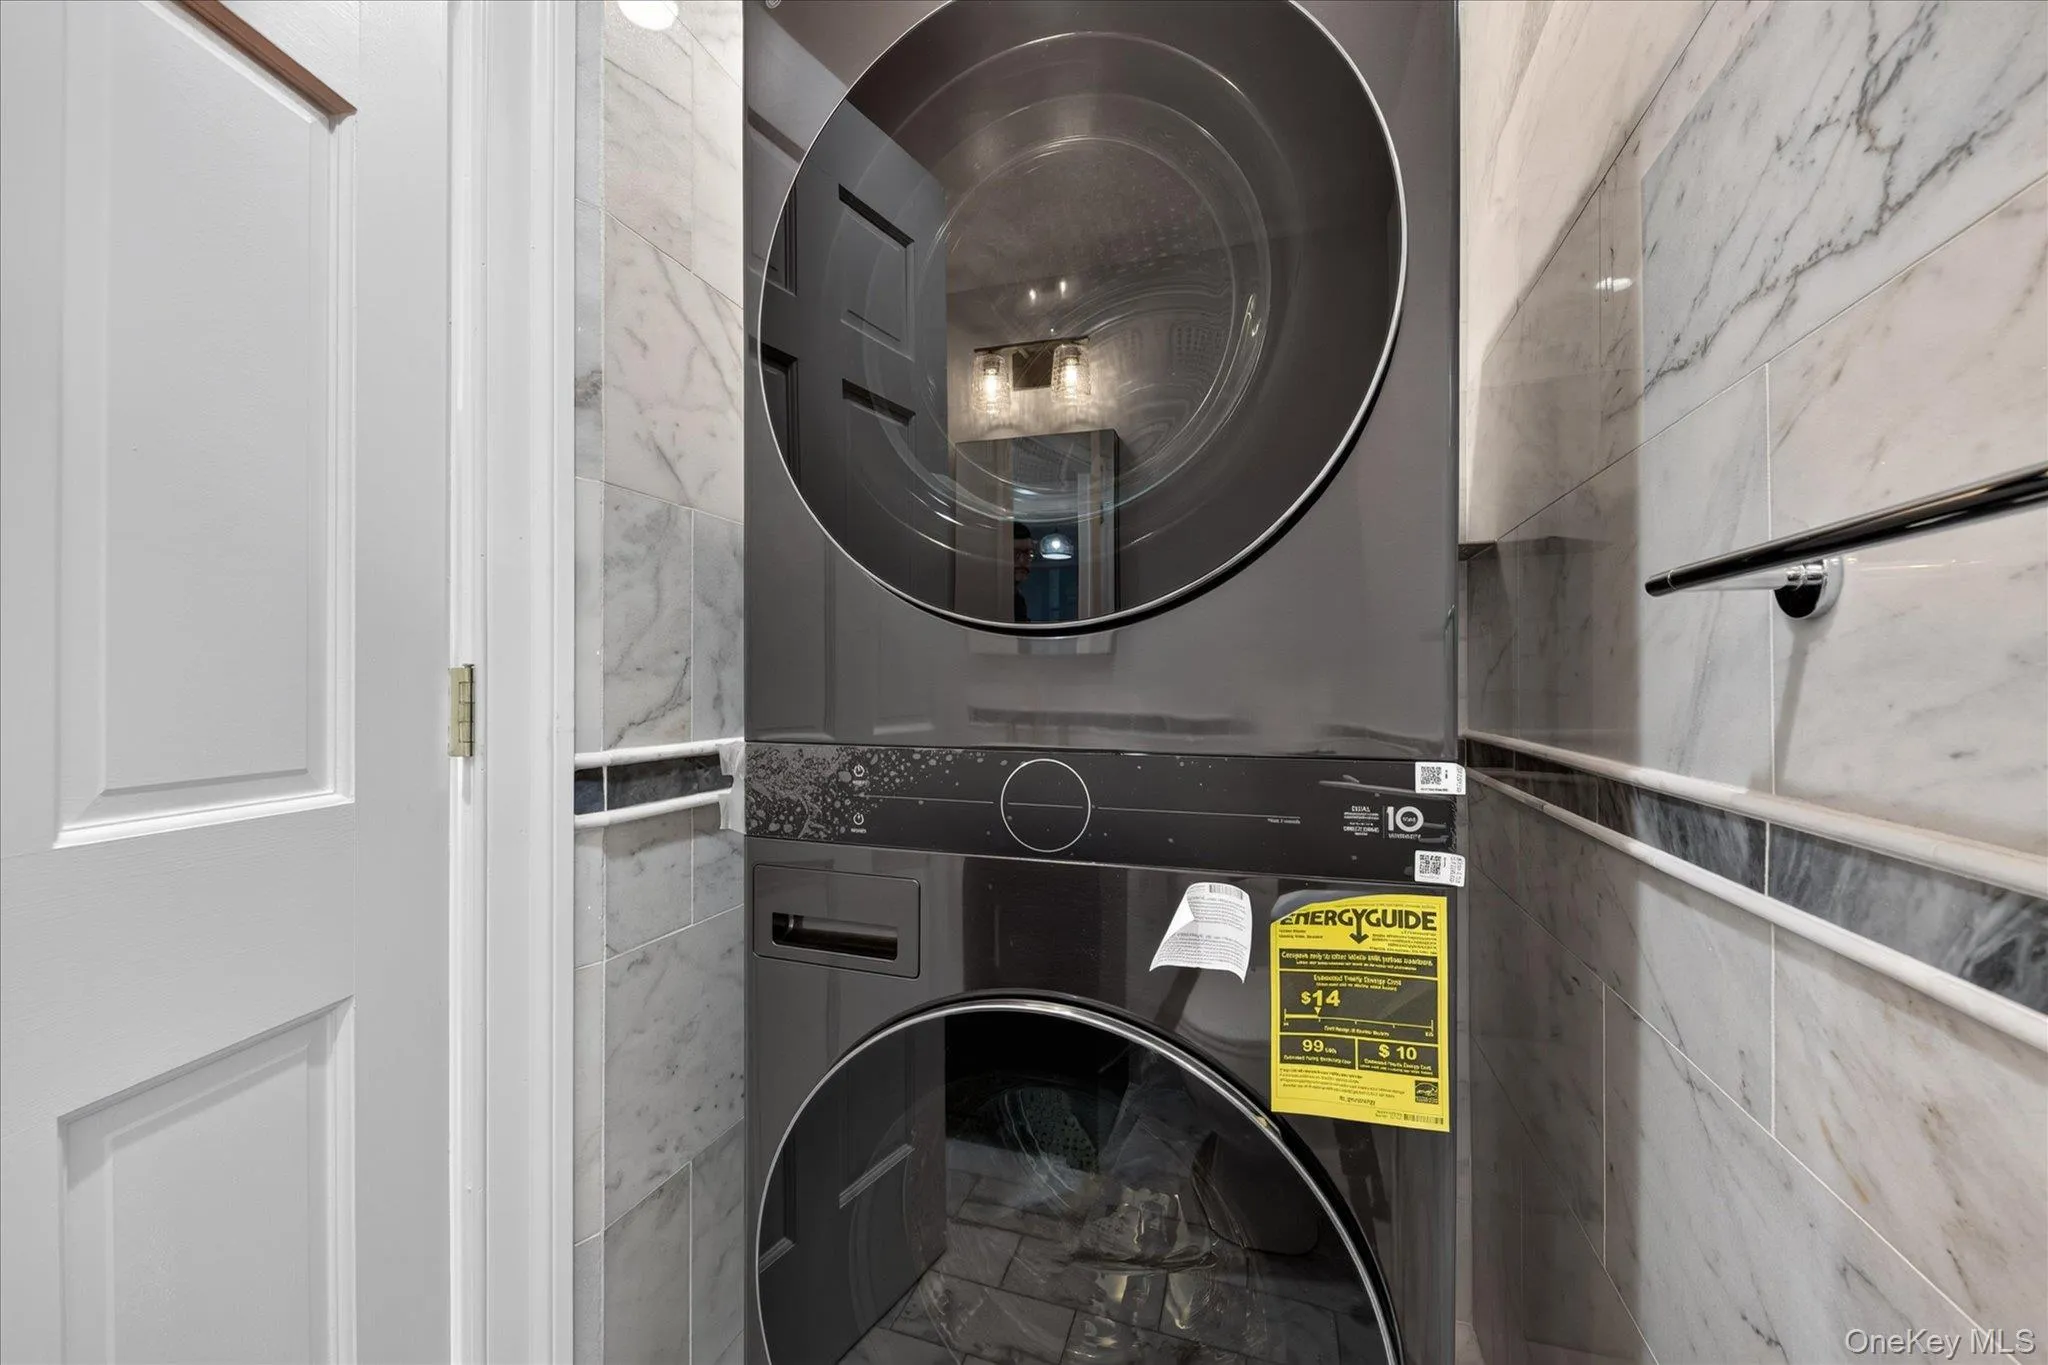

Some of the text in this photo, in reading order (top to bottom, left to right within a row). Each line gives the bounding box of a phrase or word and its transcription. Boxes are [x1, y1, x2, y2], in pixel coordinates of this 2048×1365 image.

[1386, 806, 1424, 832] 10
[1301, 990, 1341, 1007] $14
[1302, 1039, 1325, 1053] 99
